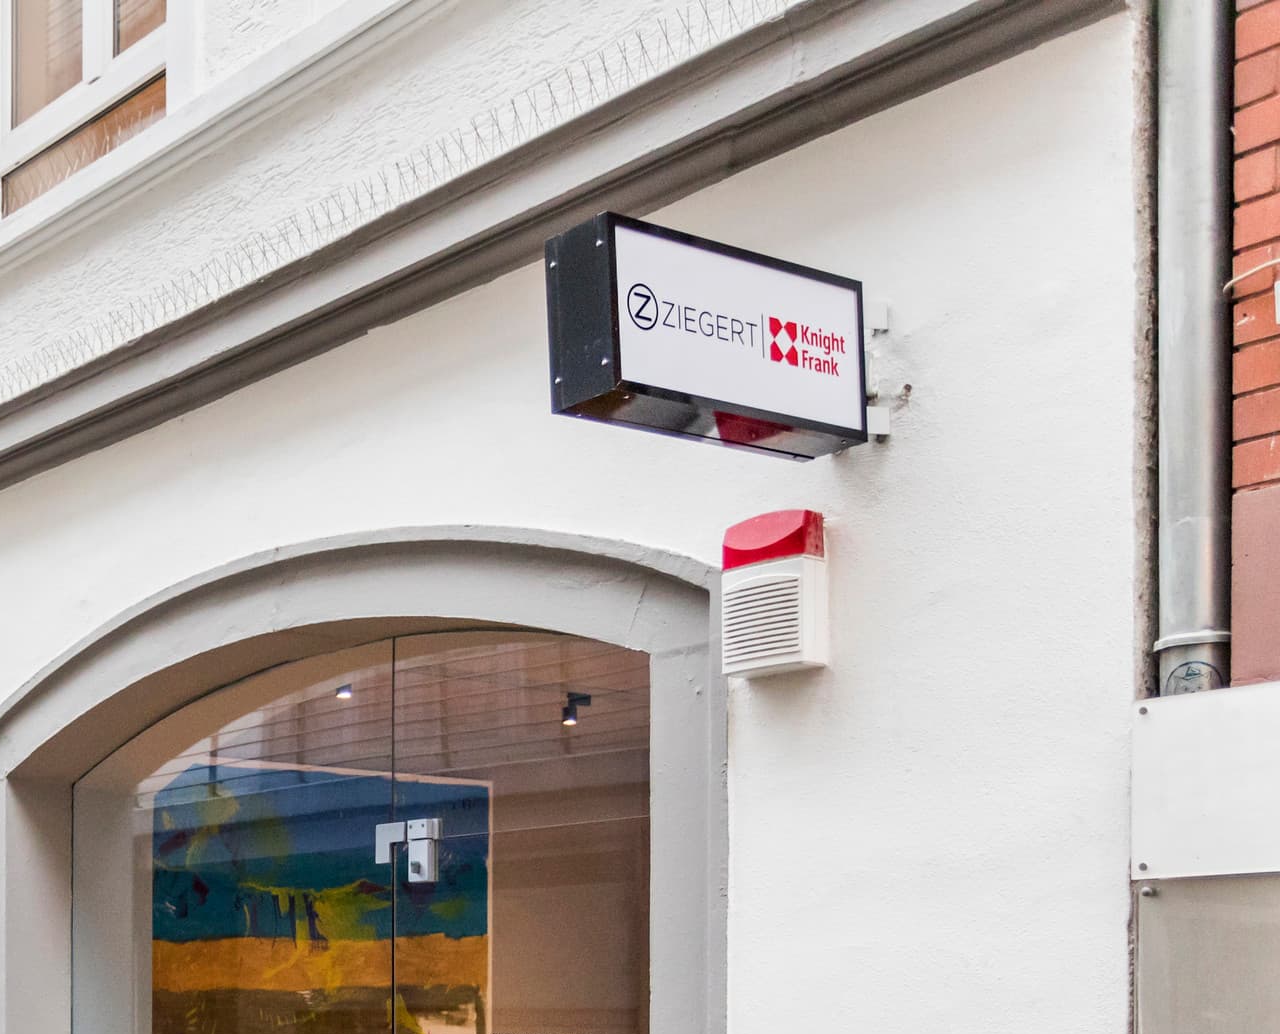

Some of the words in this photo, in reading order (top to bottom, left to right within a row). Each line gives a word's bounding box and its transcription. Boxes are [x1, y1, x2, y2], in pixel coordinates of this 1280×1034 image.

[661, 300, 759, 349] ZIEGERT
[801, 324, 846, 356] Knight
[801, 350, 840, 377] Frank
